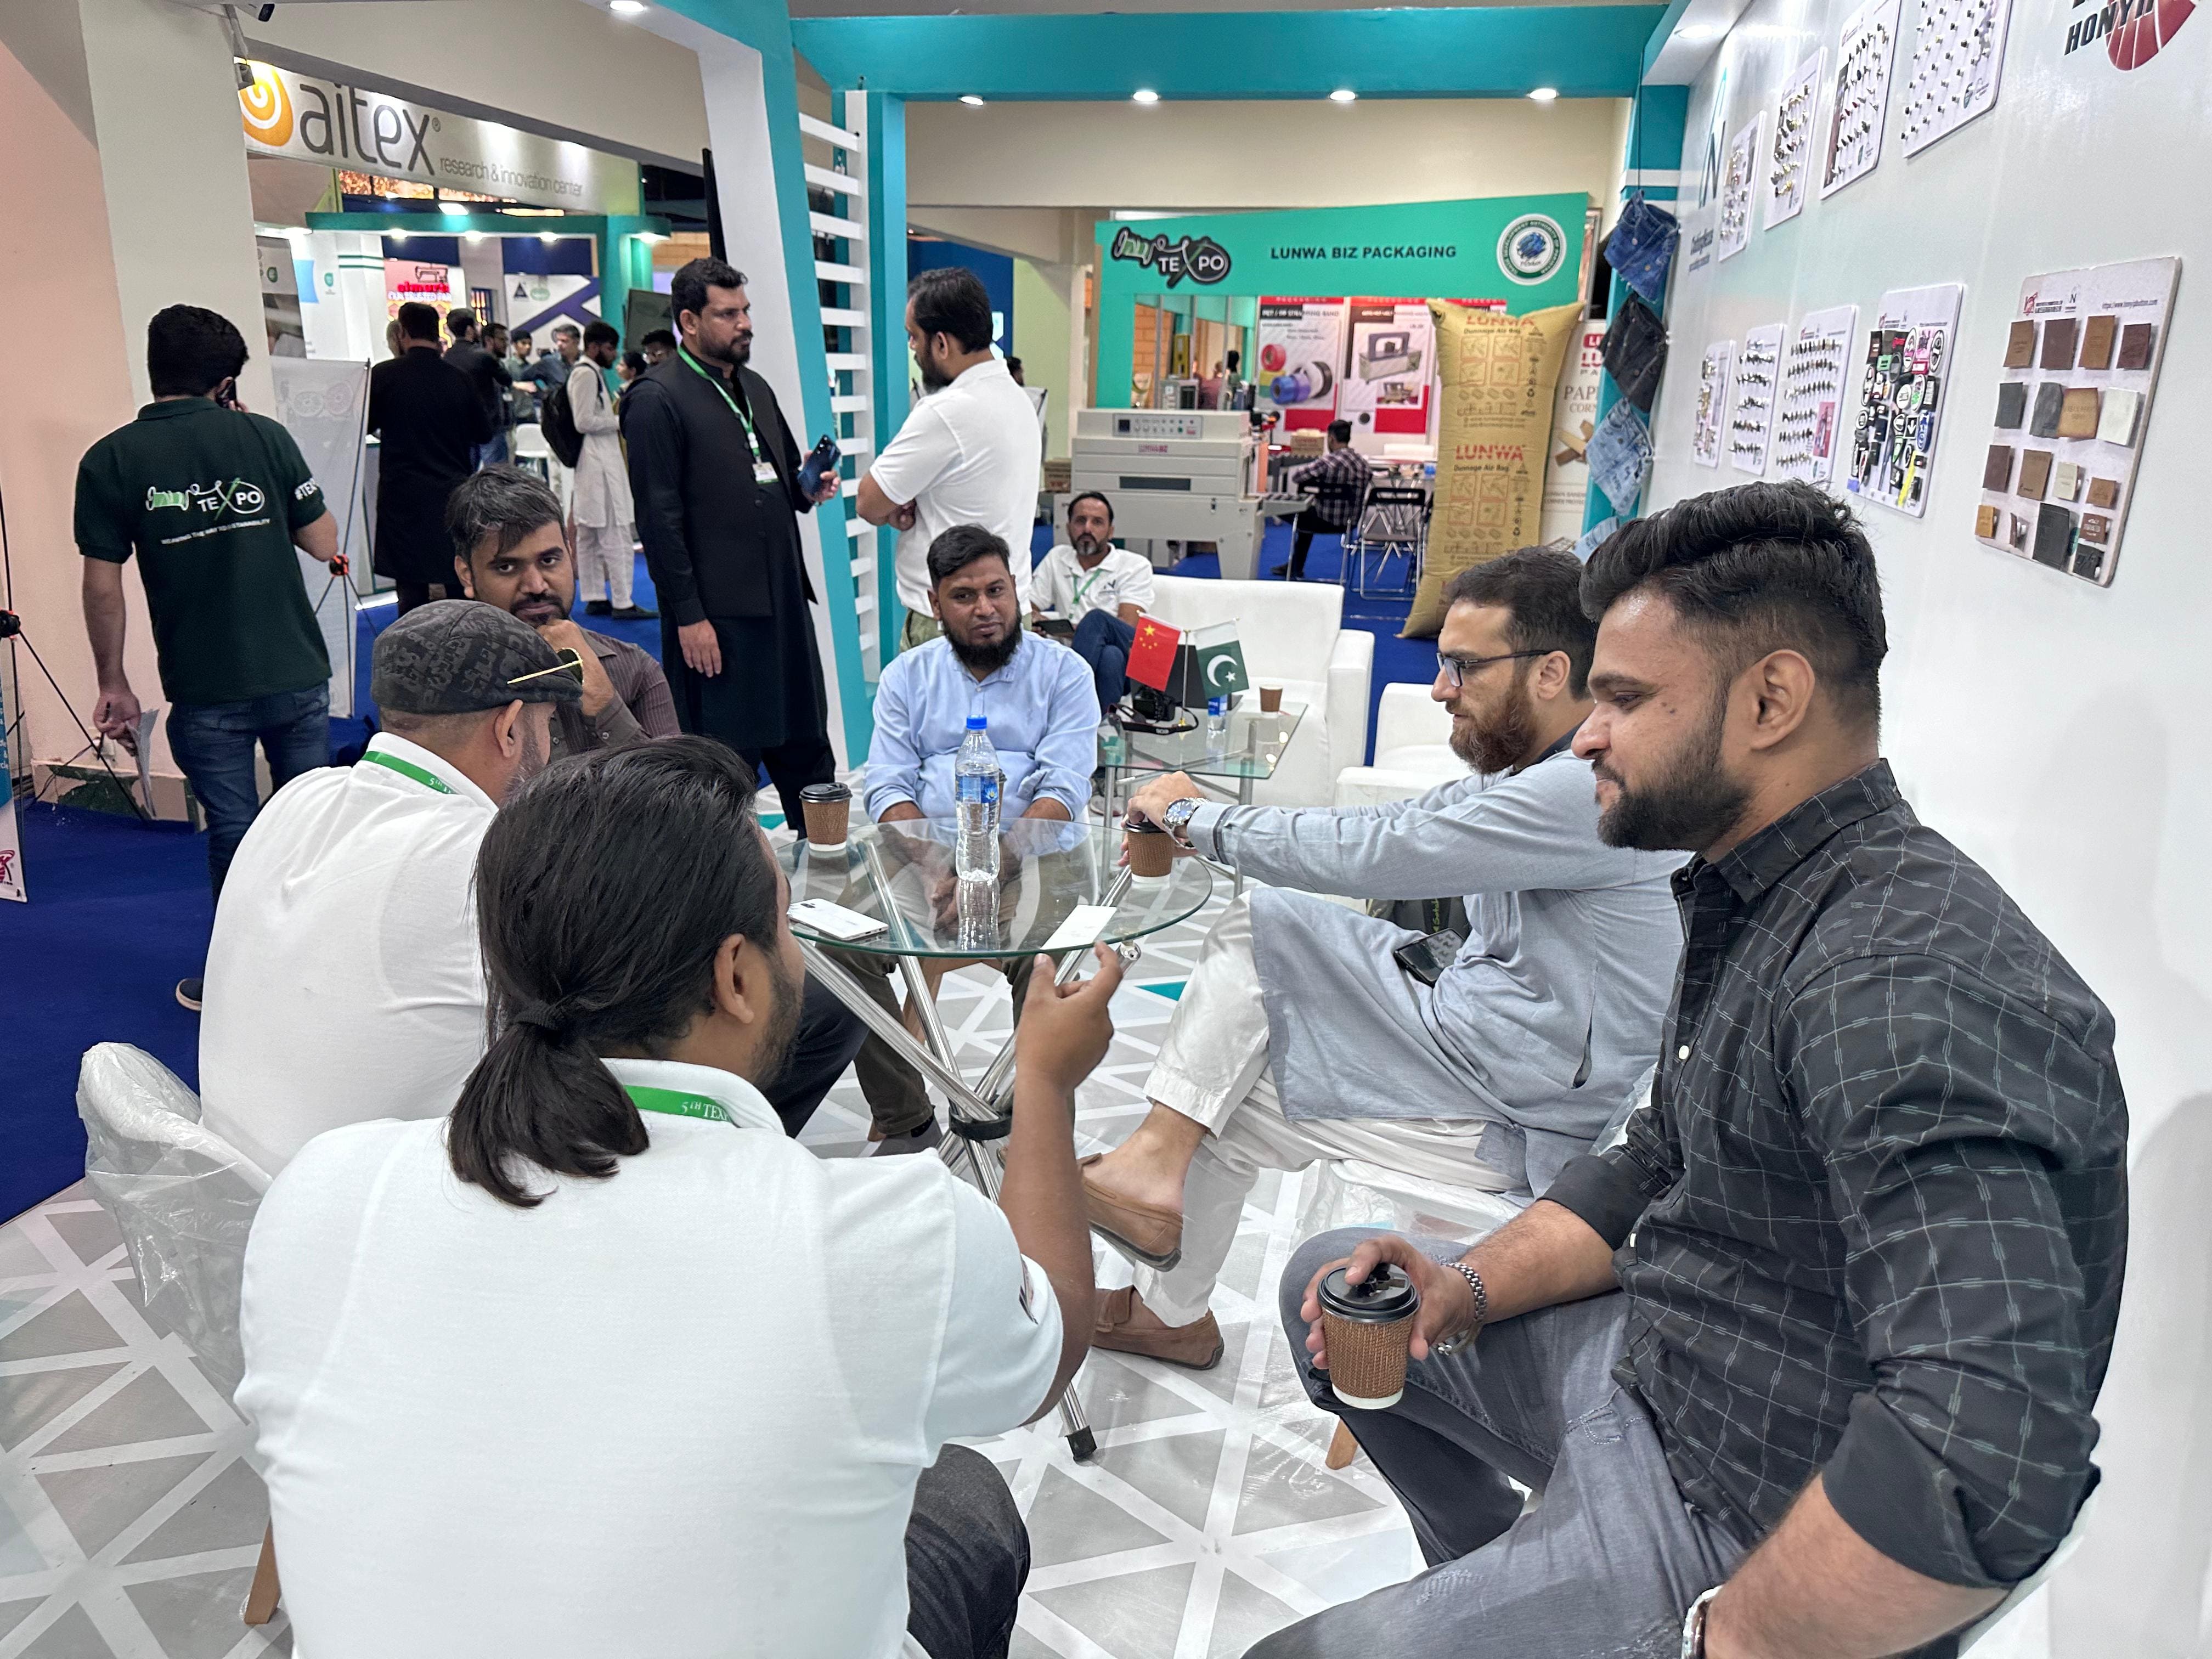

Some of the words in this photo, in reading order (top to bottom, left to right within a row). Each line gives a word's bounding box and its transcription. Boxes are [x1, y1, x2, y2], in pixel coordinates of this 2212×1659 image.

[300, 83, 435, 176] aitex
[440, 157, 489, 179] research
[492, 163, 499, 182] &
[501, 166, 550, 191] innovation
[1271, 246, 1326, 259] LUNWA
[1331, 246, 1357, 258] BIZ
[1362, 246, 1457, 258] PACKAGING
[1455, 444, 1523, 461] LUNWA
